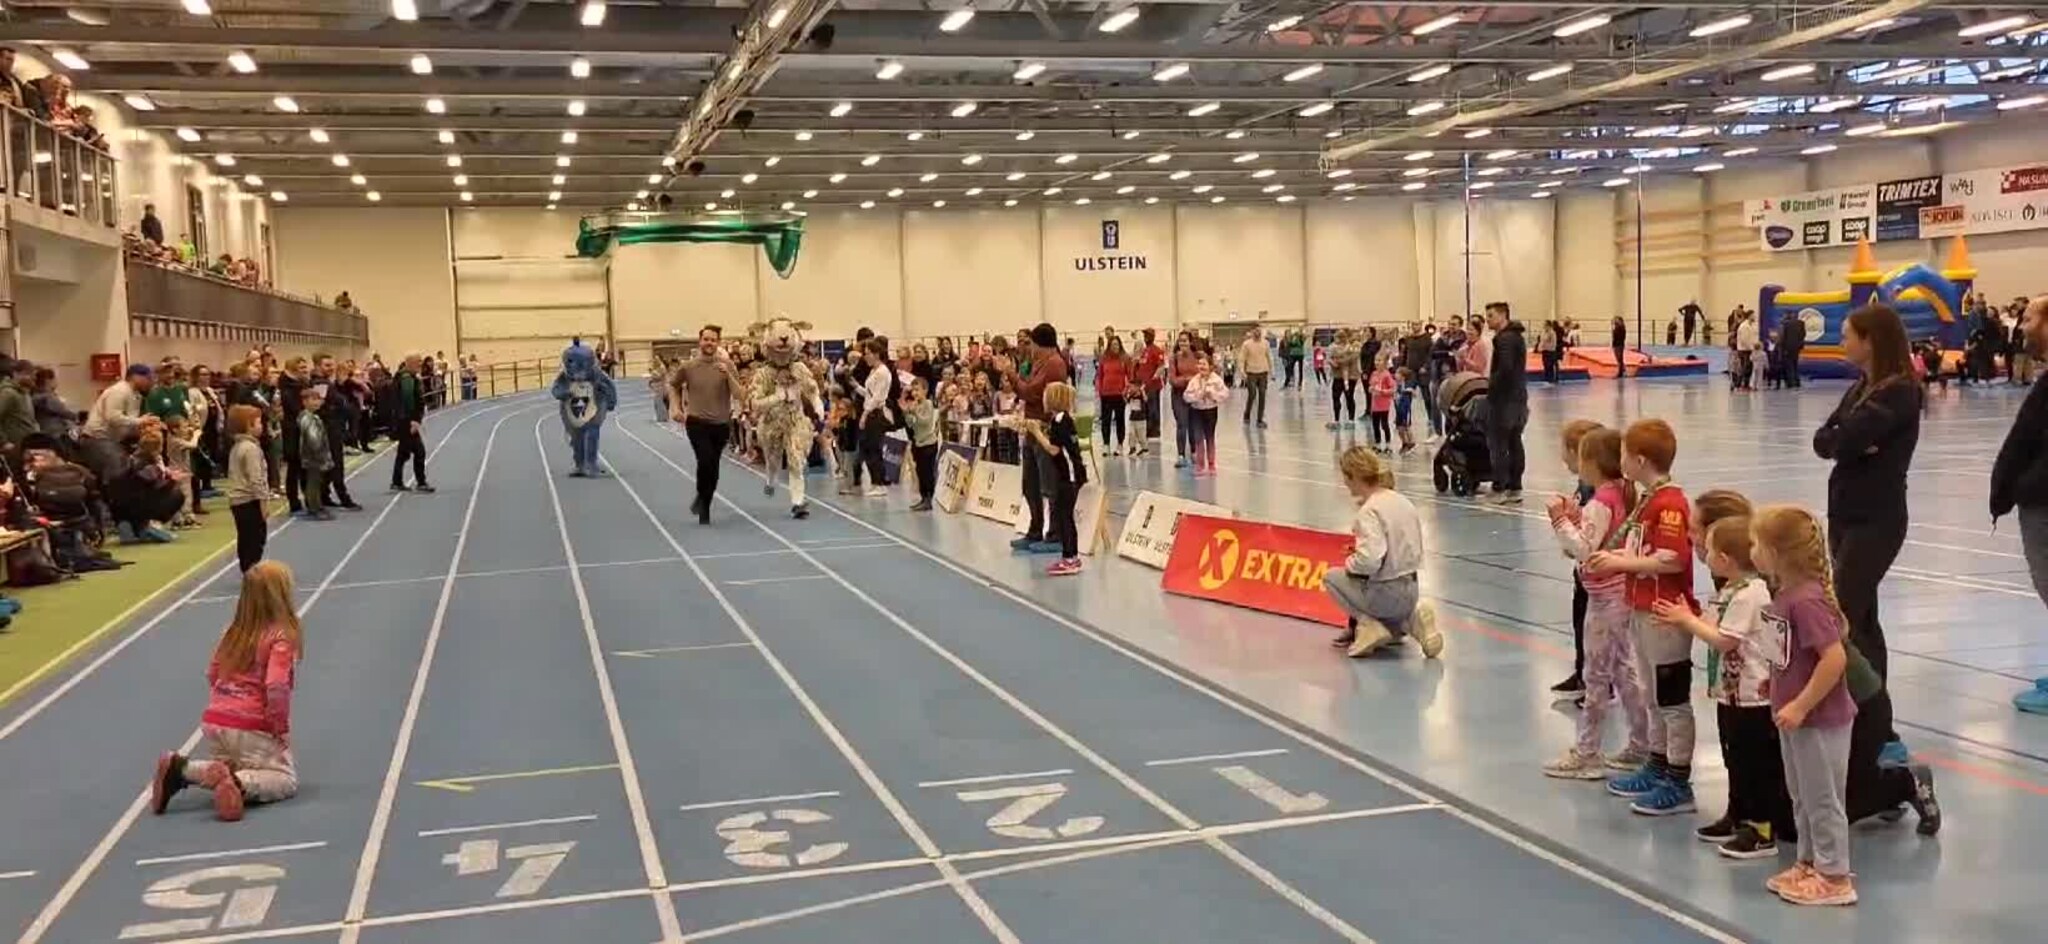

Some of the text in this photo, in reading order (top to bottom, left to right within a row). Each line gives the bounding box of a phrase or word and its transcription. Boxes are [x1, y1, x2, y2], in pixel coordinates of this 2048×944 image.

[1879, 177, 1940, 202] TRIMTEX
[1806, 224, 1827, 234] coop
[1845, 220, 1867, 230] coop
[1931, 207, 1964, 225] JOTUN
[1074, 256, 1147, 271] ULSTEIN
[1125, 531, 1151, 550] ULSTEIN
[1240, 549, 1330, 592] EXTRA
[1212, 765, 1330, 814] 1
[956, 782, 1106, 839] 2
[715, 809, 850, 867] 3
[441, 839, 579, 898] 4
[117, 863, 287, 940] 5
